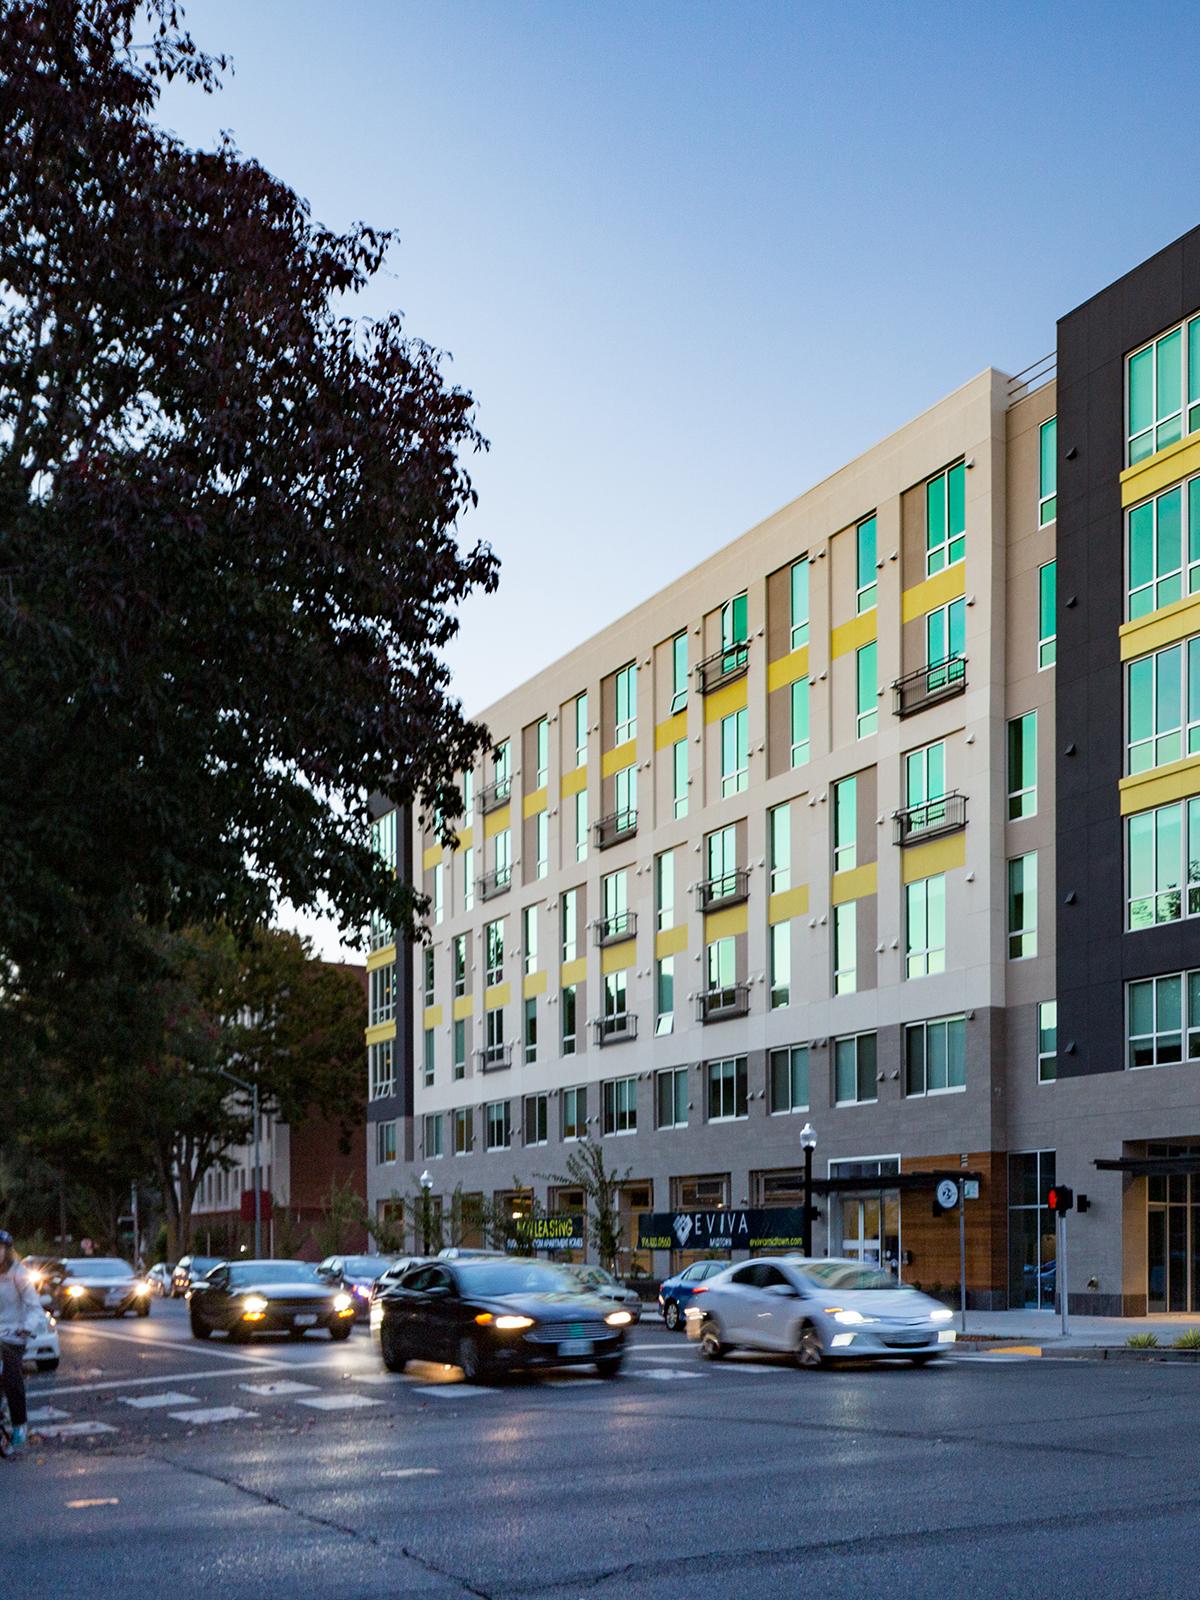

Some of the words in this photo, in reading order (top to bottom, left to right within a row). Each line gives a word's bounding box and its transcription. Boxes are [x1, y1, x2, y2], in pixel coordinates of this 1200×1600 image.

[534, 1217, 574, 1238] LEASING
[694, 1212, 749, 1235] EVIVA
[749, 1236, 803, 1247] evivamidtown.com
